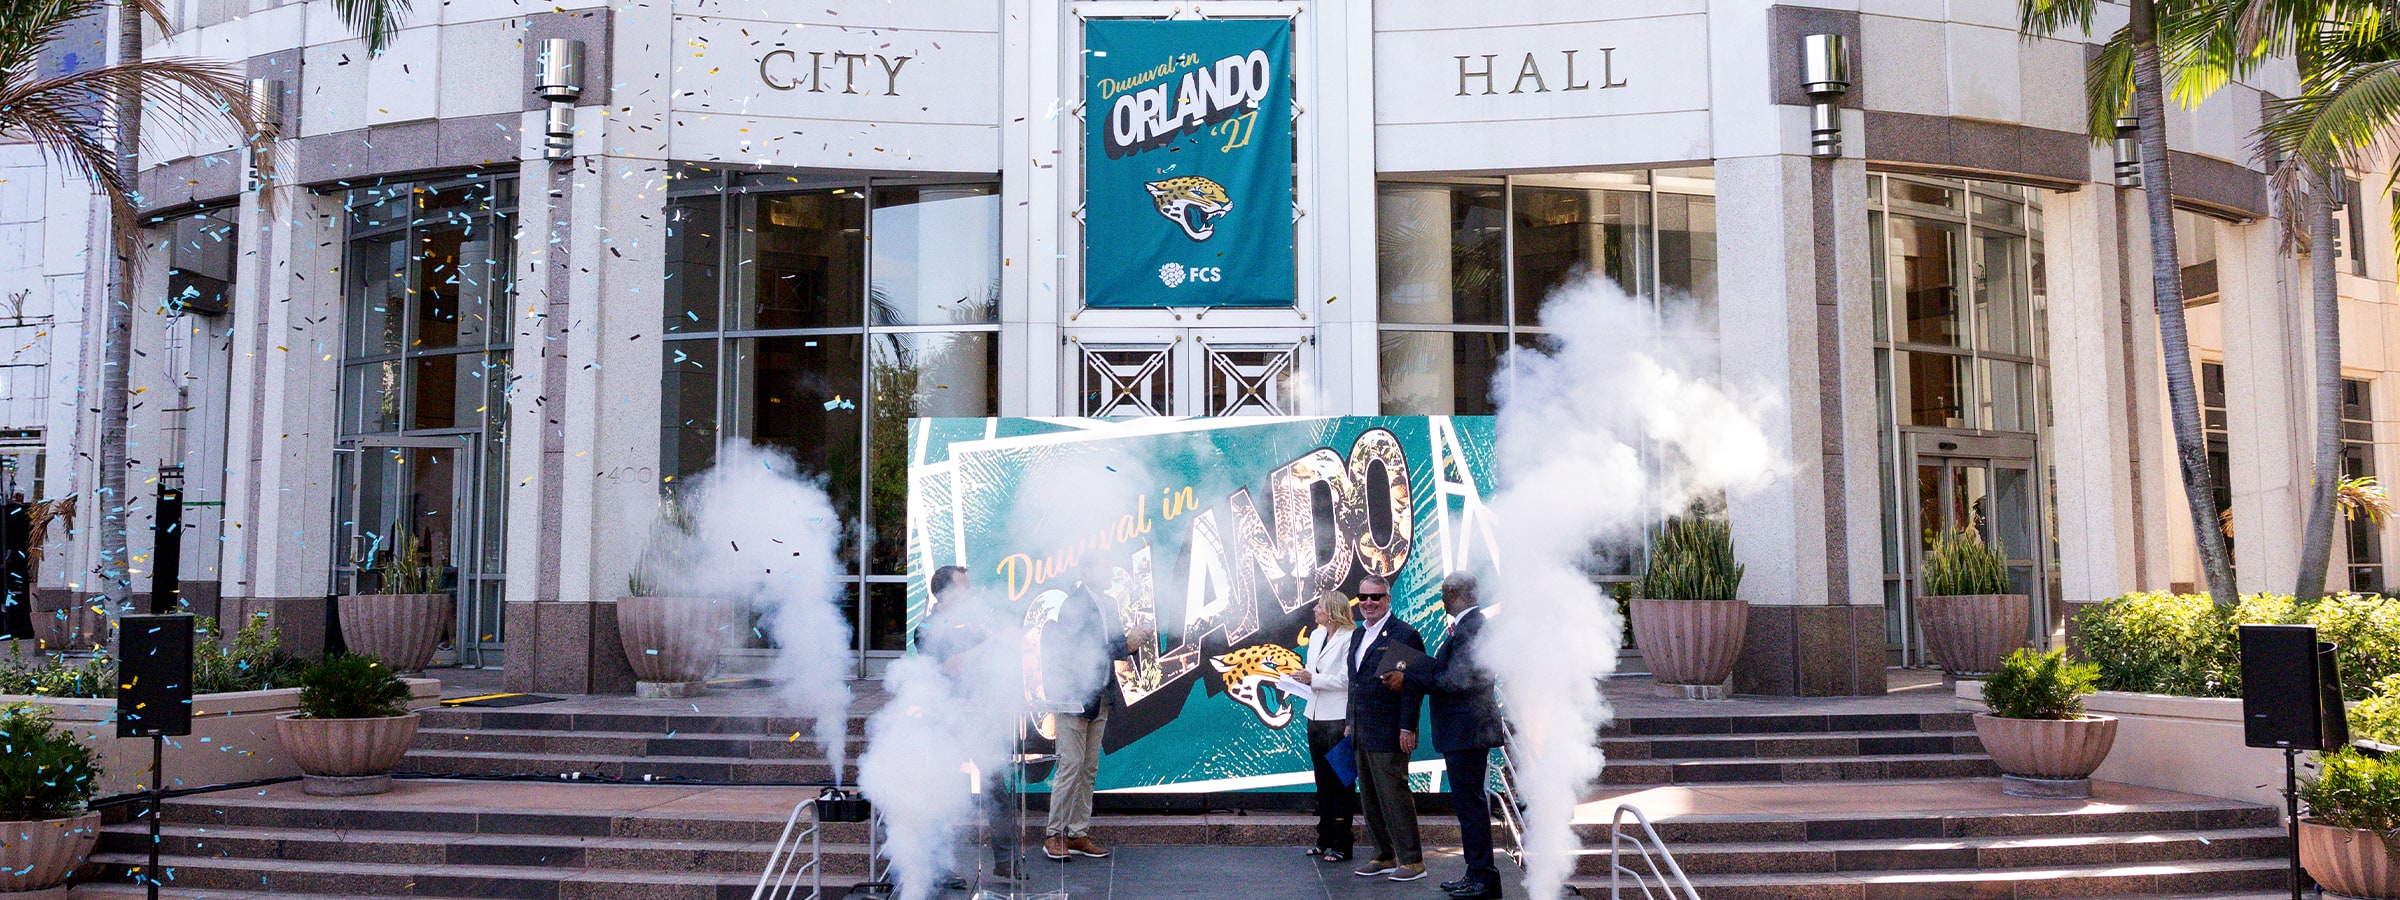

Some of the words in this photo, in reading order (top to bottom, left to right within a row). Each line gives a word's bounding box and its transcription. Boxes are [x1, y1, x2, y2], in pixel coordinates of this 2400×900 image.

[760, 49, 912, 96] CITY
[1453, 47, 1627, 96] HALL
[1097, 55, 1176, 100] Duuuval
[1180, 53, 1200, 69] in
[1112, 49, 1270, 147] ORLANDO
[1189, 267, 1221, 283] FCS
[607, 466, 652, 485] 400
[1163, 486, 1199, 521] in
